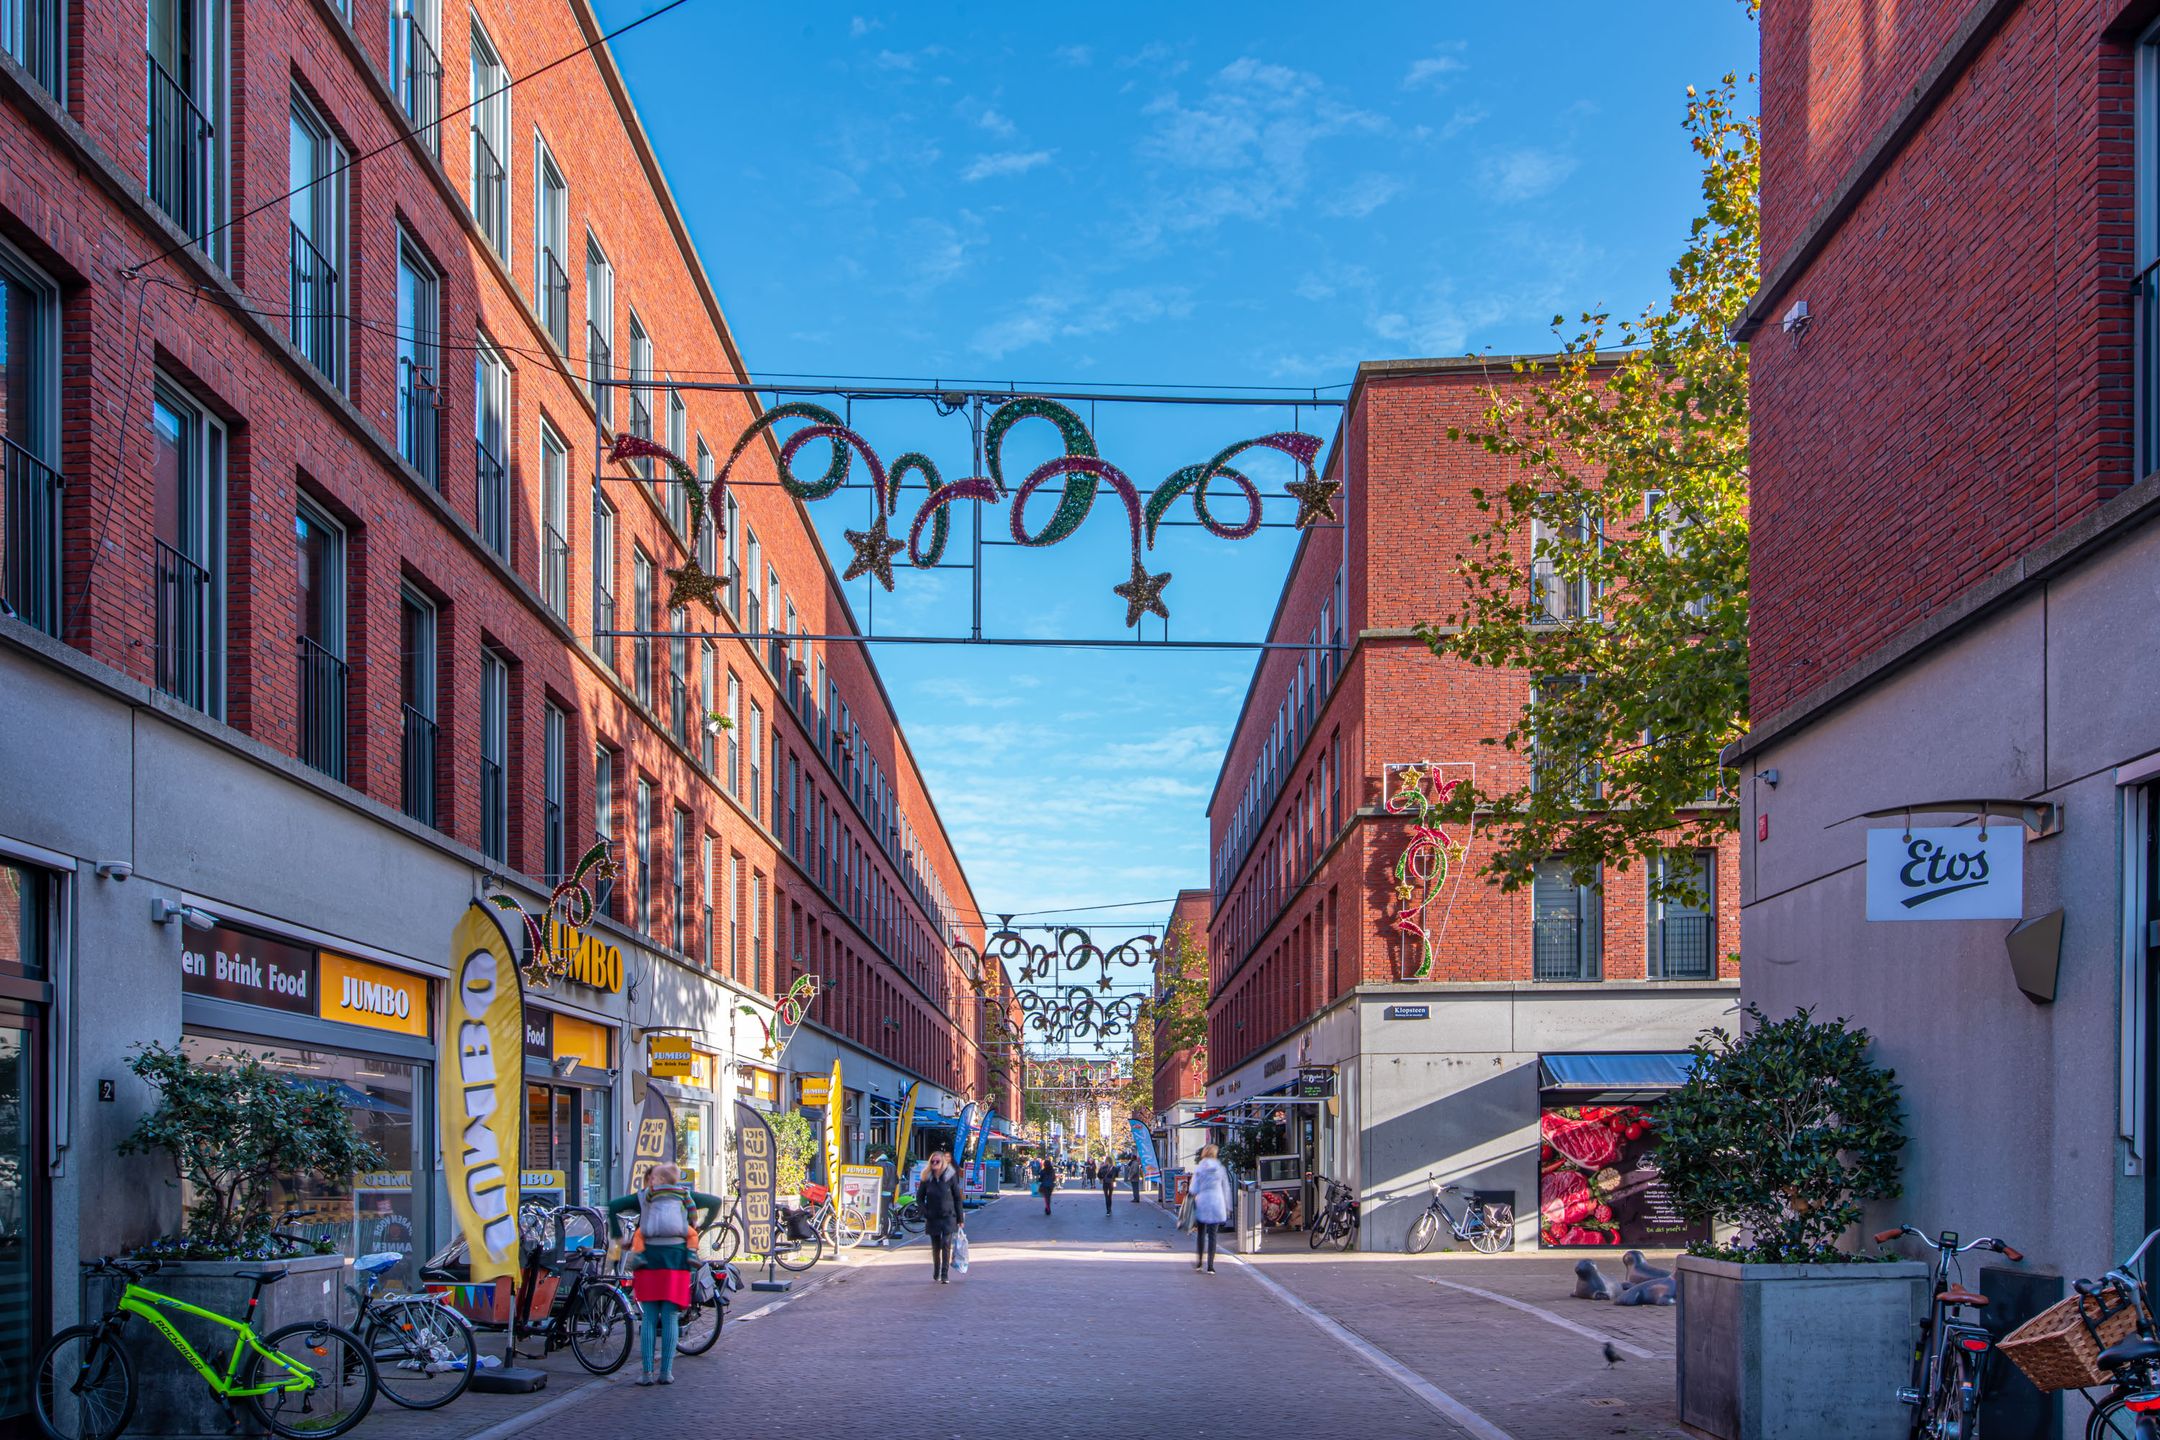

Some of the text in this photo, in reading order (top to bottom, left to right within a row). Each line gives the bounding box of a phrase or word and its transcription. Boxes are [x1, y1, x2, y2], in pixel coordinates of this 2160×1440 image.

[1900, 839, 1989, 888] Etos
[182, 944, 306, 998] en Brink Food
[341, 976, 409, 1019] JUMBO
[527, 1024, 545, 1046] Food
[654, 1052, 691, 1060] JUMBO
[846, 1167, 877, 1175] JUMBO
[155, 1318, 205, 1371] ROCKRIDER
